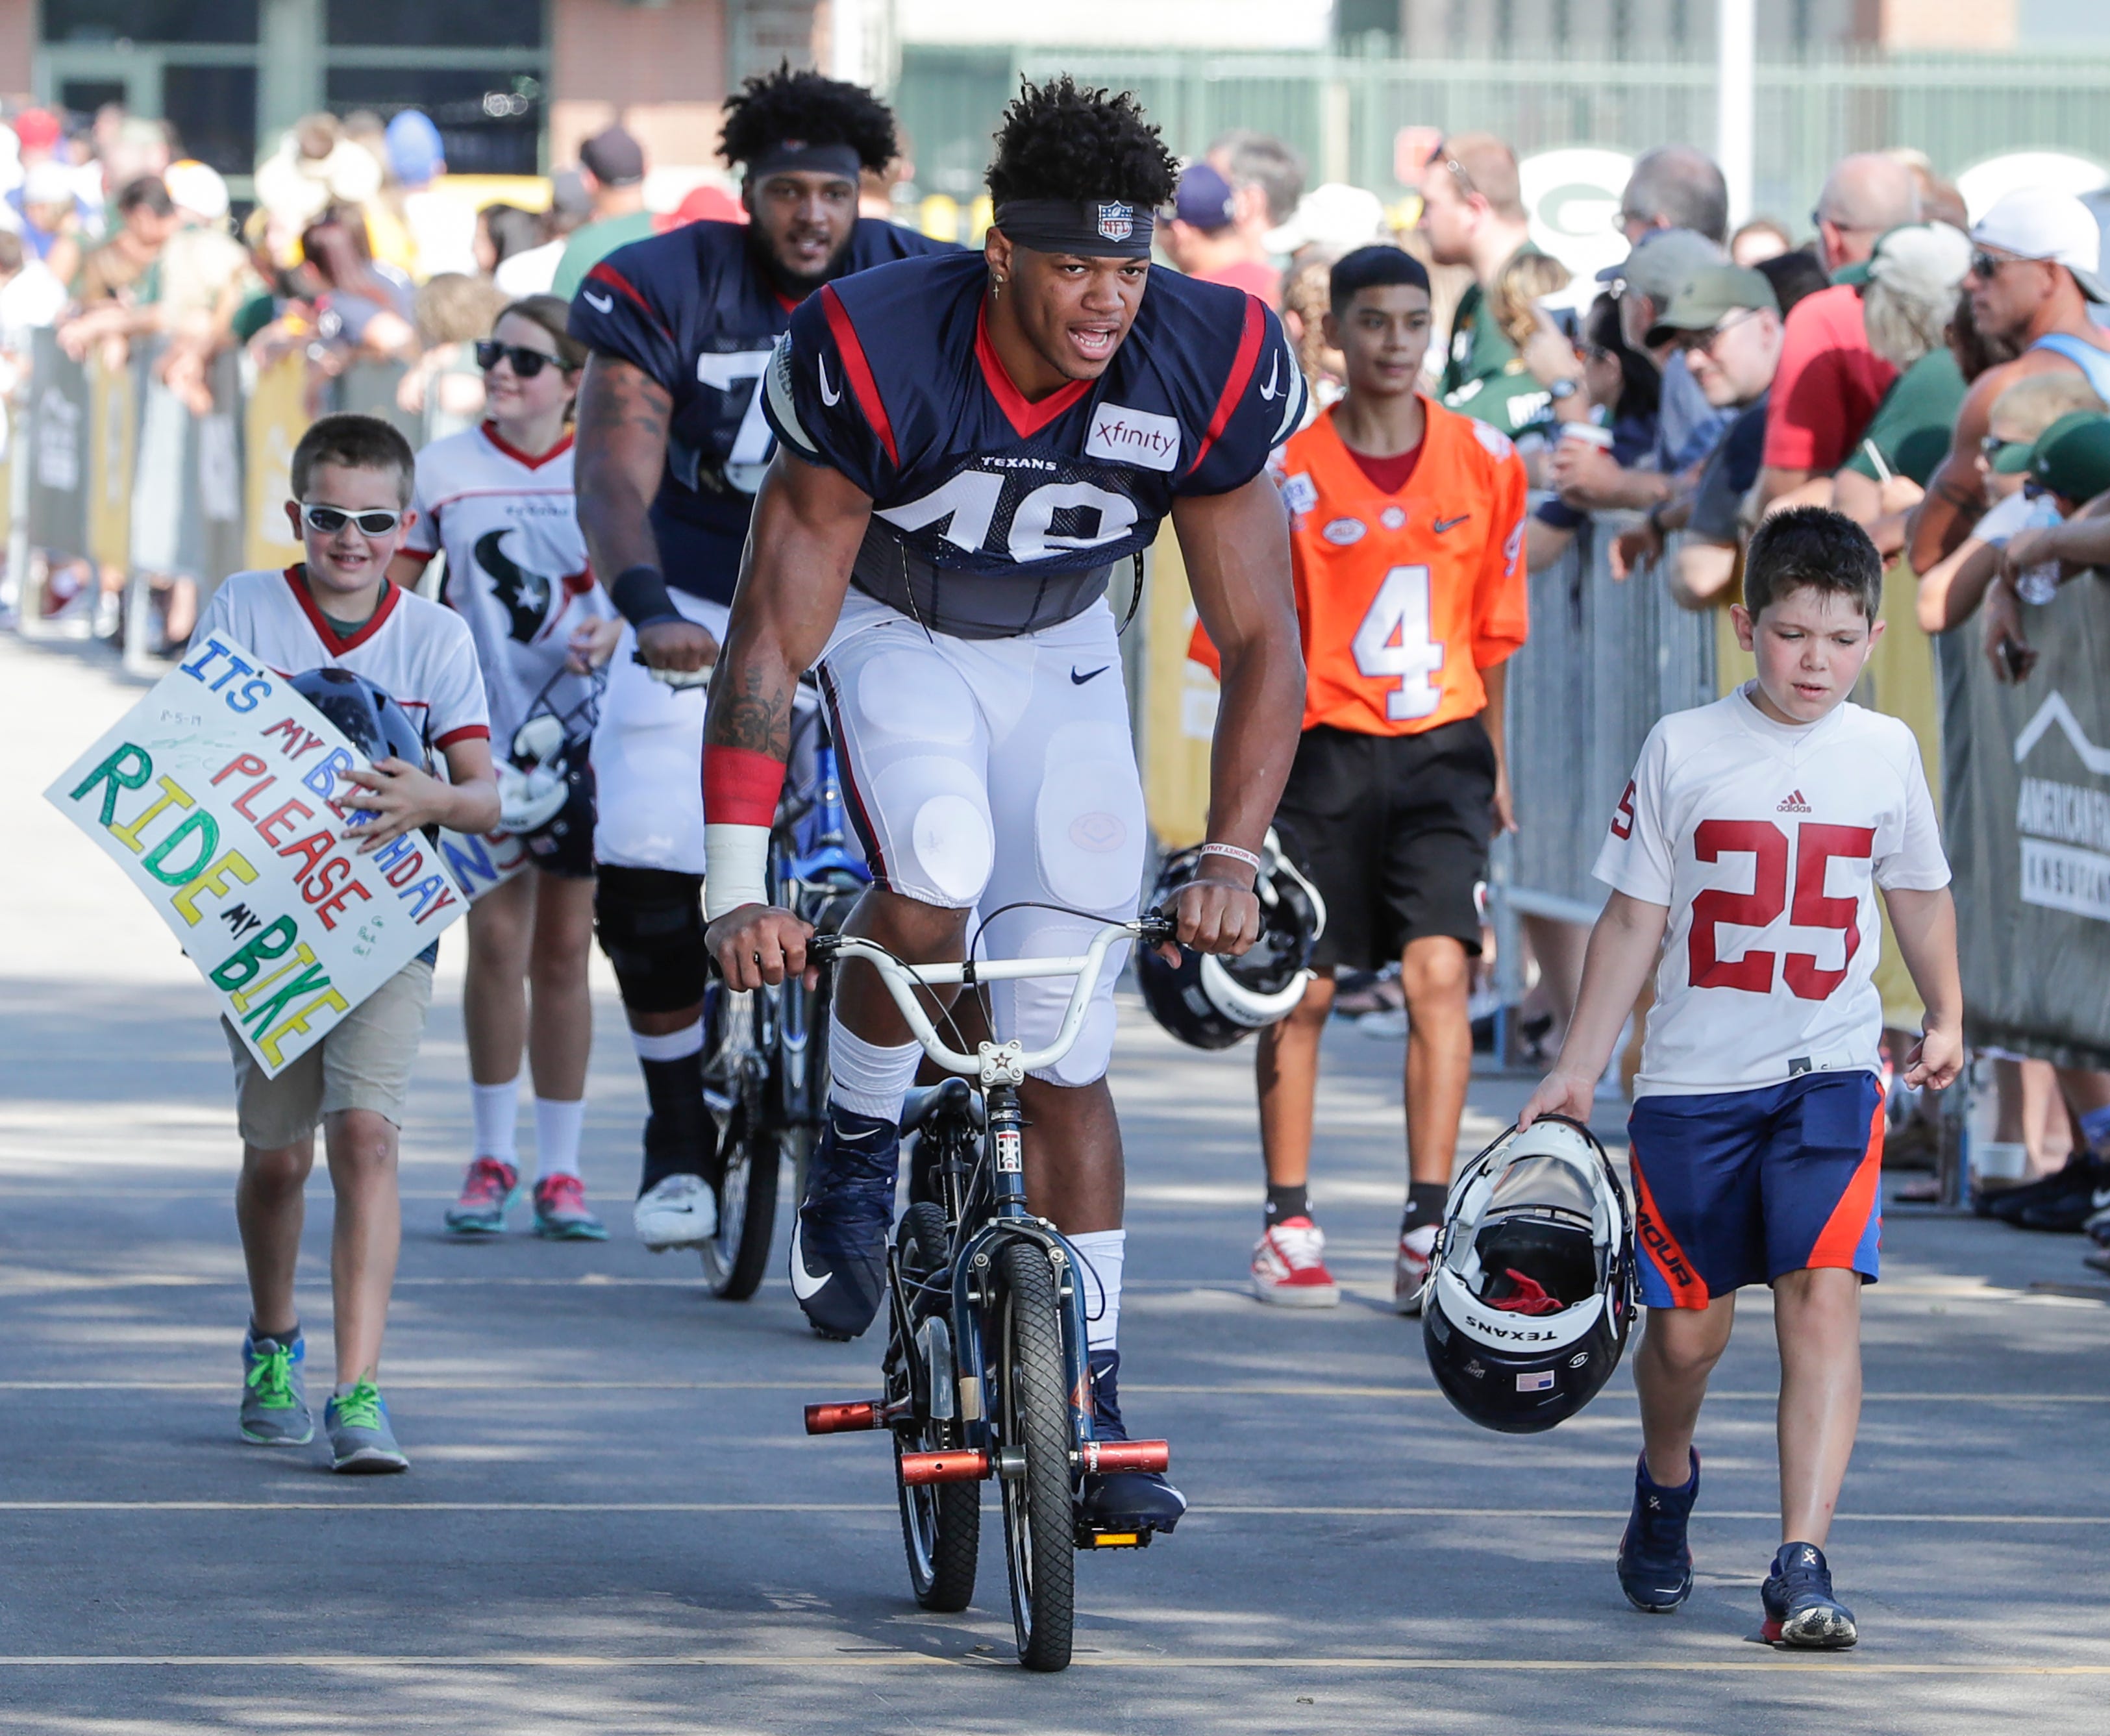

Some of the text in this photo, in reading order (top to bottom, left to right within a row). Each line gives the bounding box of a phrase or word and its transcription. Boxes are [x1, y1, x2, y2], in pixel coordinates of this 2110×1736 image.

[1104, 221, 1129, 235] NFL
[981, 456, 1057, 471] TEXANS
[1096, 421, 1176, 458] xfinity
[1351, 564, 1443, 721] 4
[180, 638, 271, 714] IT'S
[261, 717, 325, 761] MY
[69, 741, 260, 928] RIDE
[210, 752, 373, 932] PLEASE
[1777, 804, 1811, 813] adidas
[220, 902, 262, 941] MY
[1688, 819, 1877, 1000] 25
[209, 913, 349, 1069] BIKE
[1465, 1315, 1558, 1341] TEXANS
